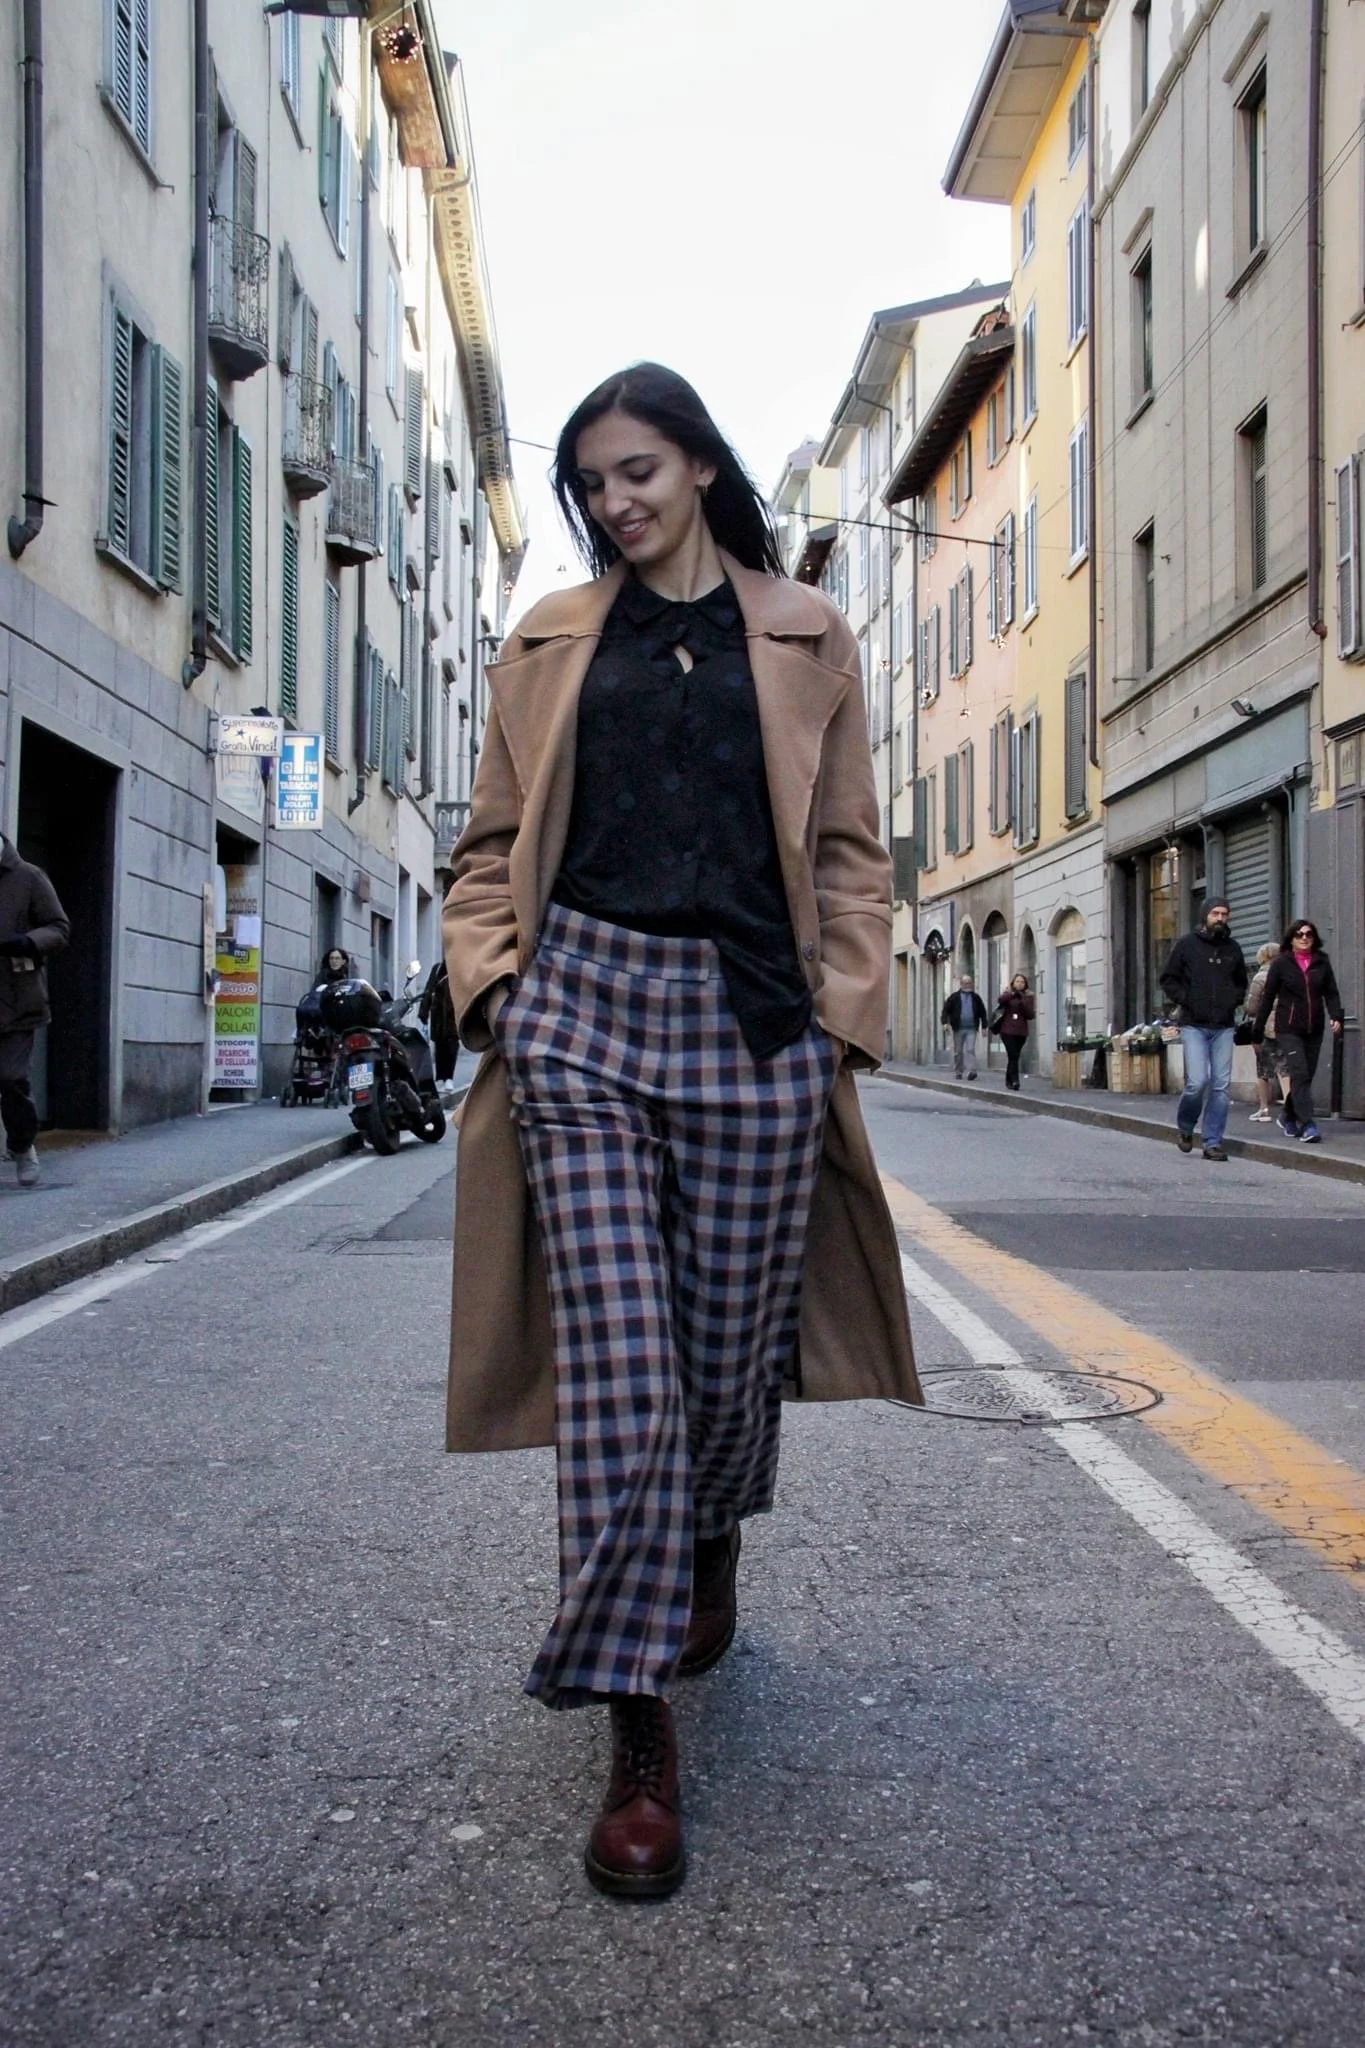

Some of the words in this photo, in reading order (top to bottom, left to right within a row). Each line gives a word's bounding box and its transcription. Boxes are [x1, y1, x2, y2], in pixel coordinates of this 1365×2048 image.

[249, 735, 277, 752] Vinci!
[285, 736, 315, 775] T
[280, 810, 316, 821] LOTTO
[215, 1007, 254, 1017] VALORI
